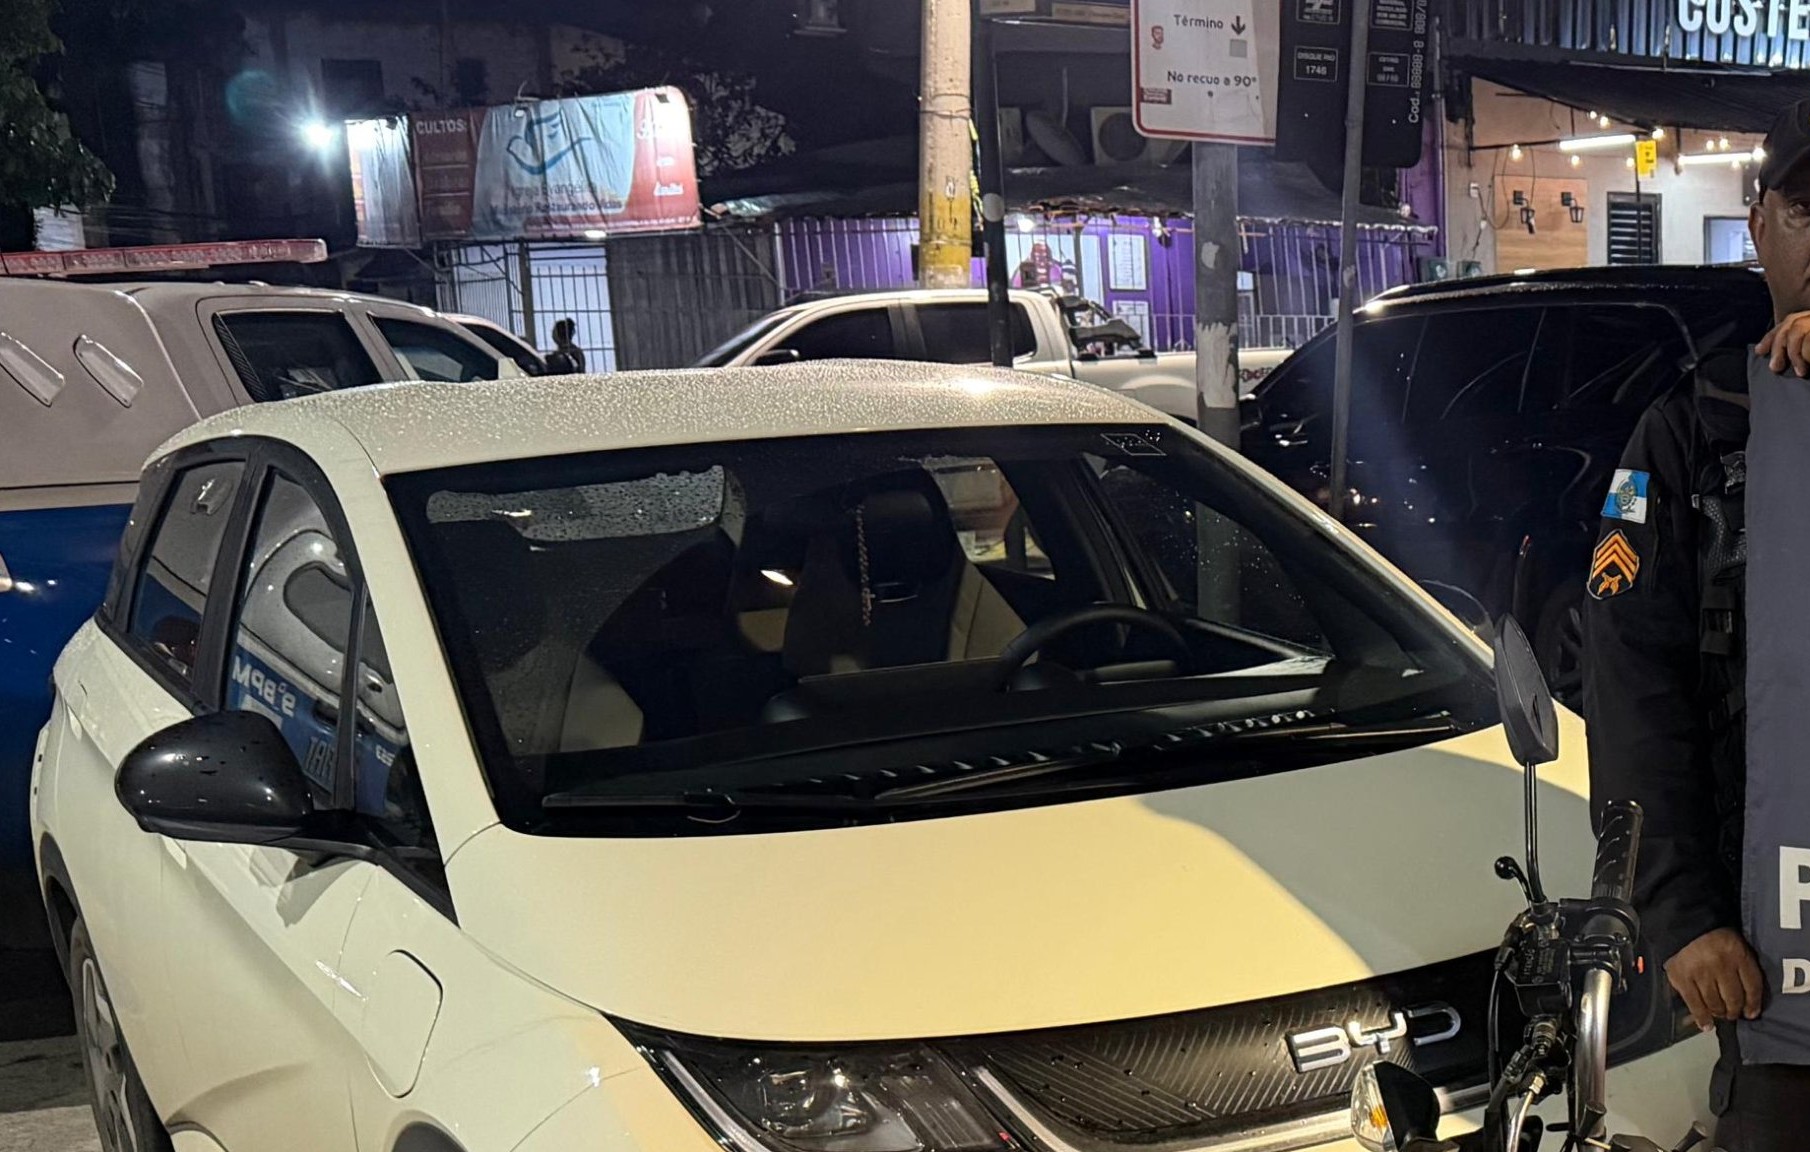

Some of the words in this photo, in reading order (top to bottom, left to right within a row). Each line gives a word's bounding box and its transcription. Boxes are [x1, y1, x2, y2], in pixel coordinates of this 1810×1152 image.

[1173, 14, 1224, 30] Término
[1167, 70, 1183, 83] No
[1187, 74, 1220, 85] recuo
[1223, 77, 1231, 86] a
[1287, 1001, 1462, 1073] BYD
